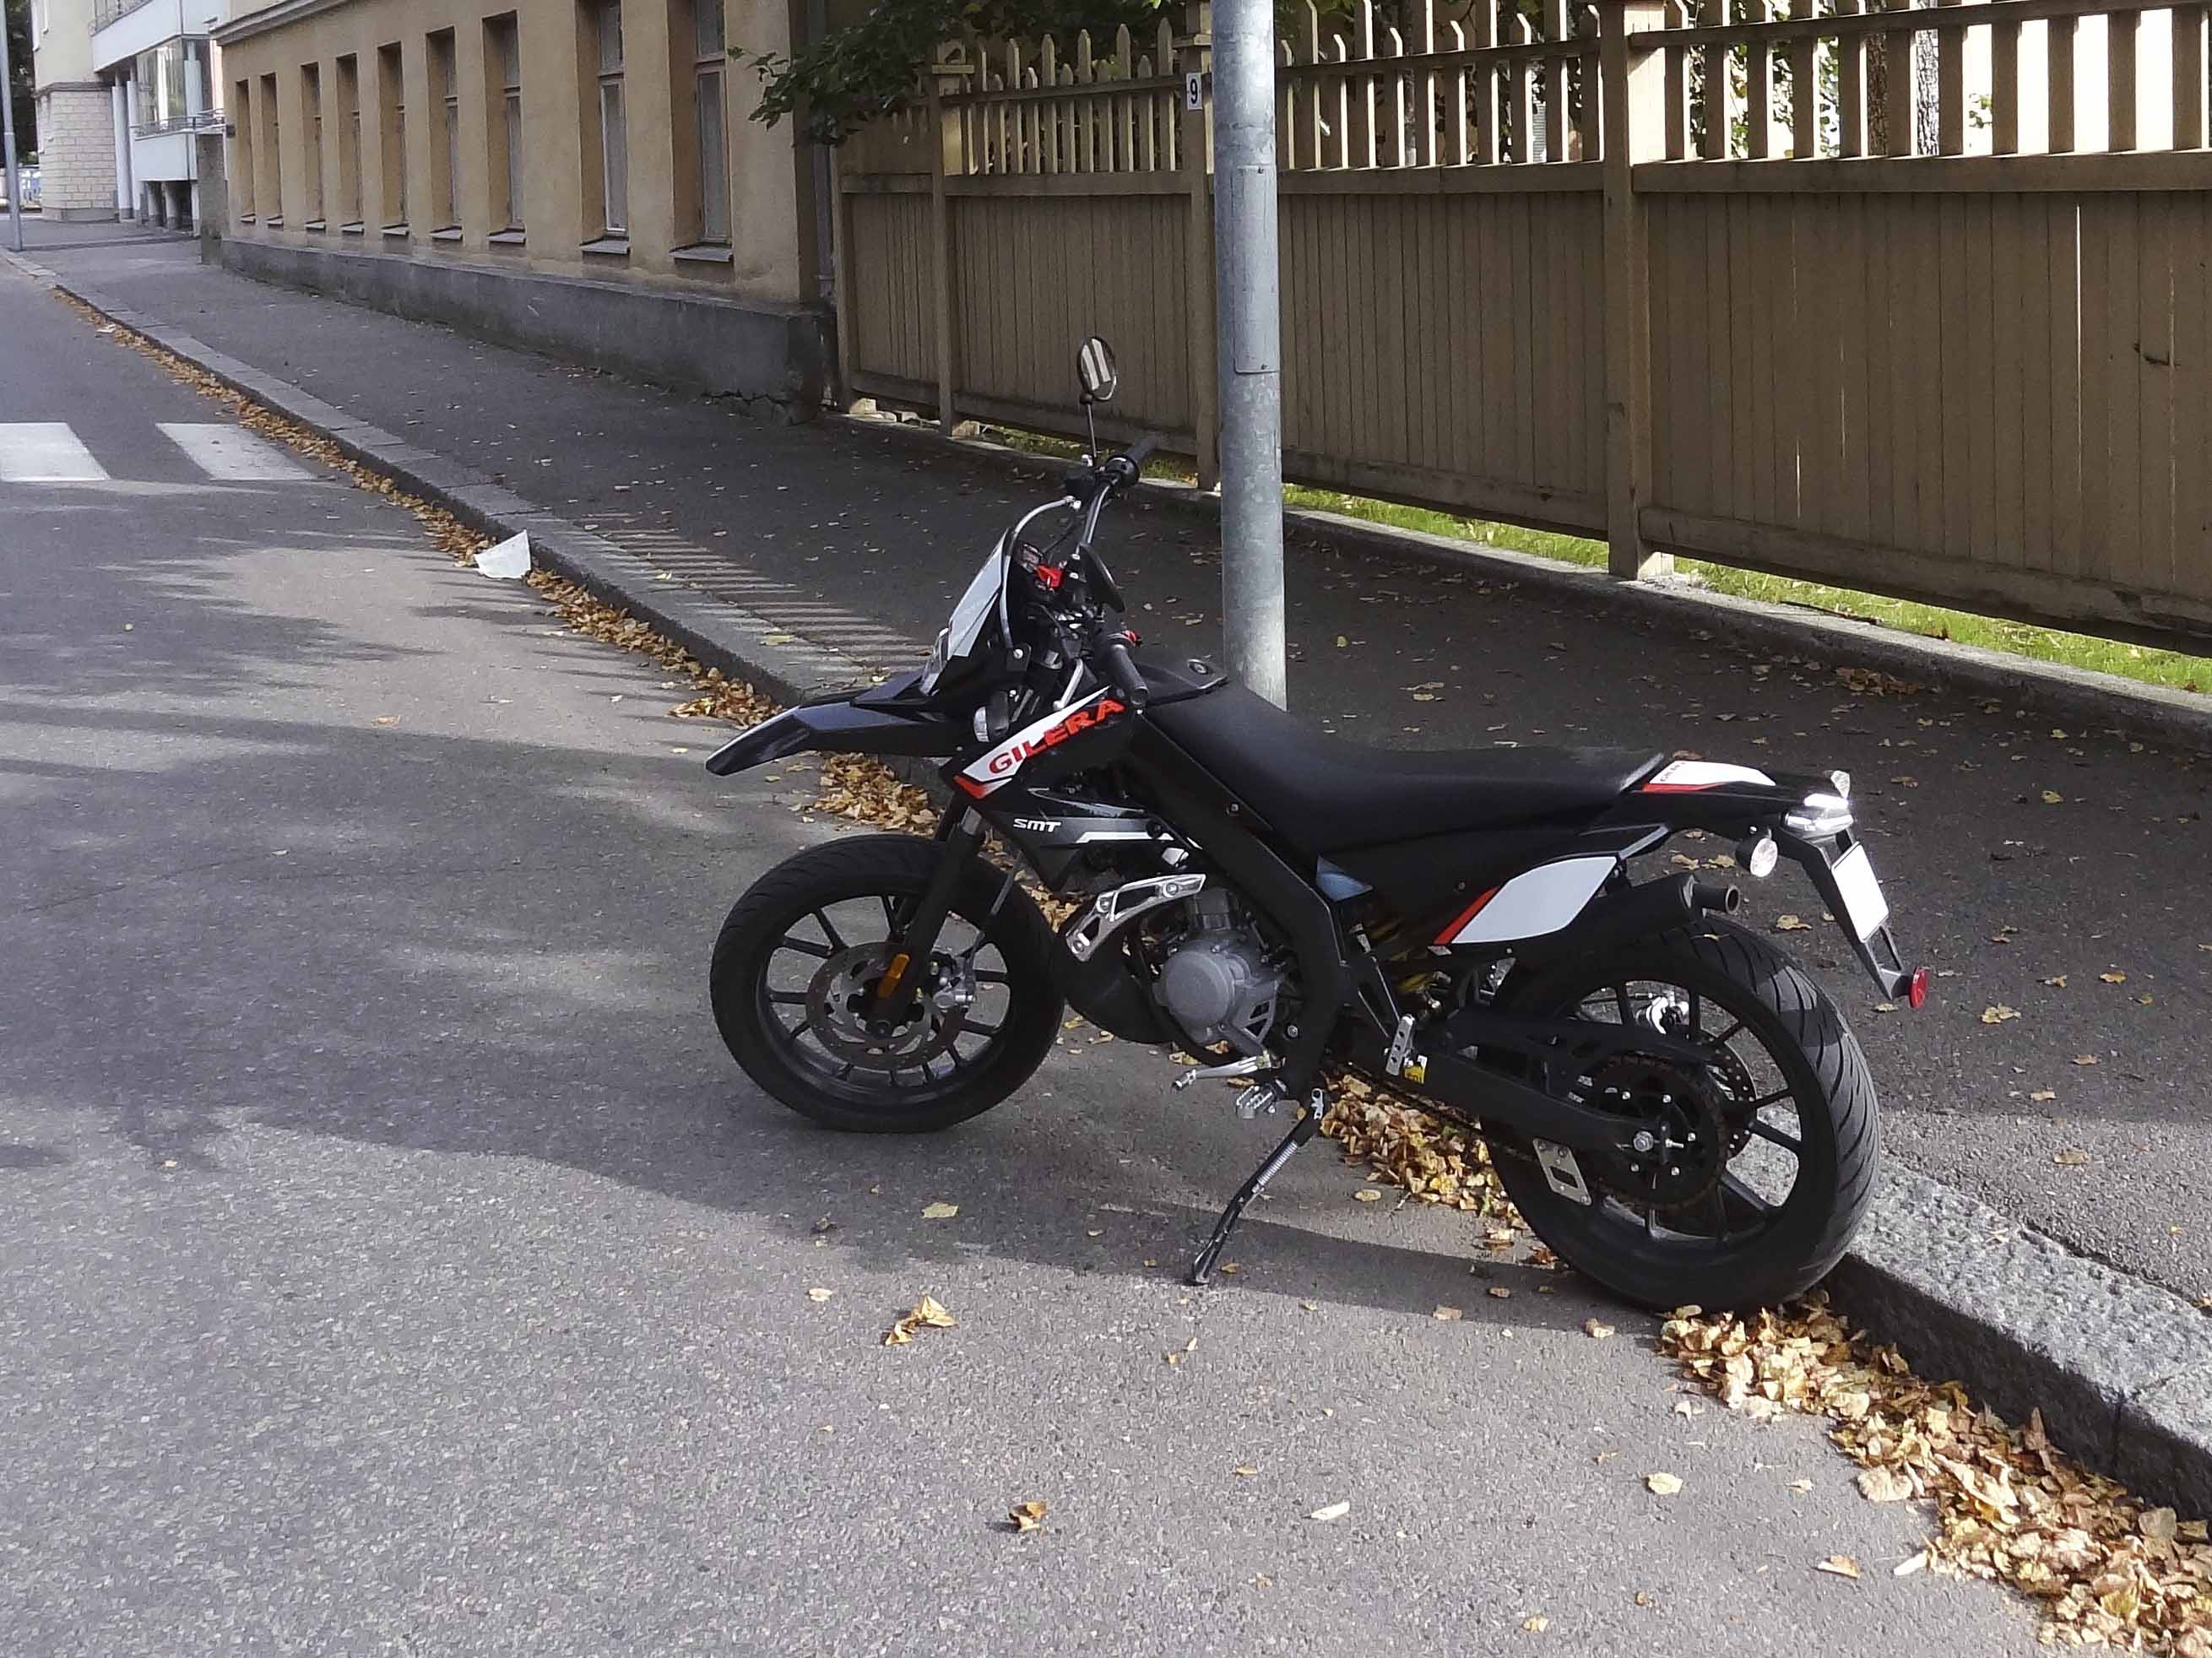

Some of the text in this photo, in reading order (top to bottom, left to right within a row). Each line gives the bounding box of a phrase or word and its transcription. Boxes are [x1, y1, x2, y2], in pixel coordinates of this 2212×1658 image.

[1190, 78, 1198, 105] 9
[989, 698, 1126, 774] GILERA
[1013, 818, 1062, 832] SMT
